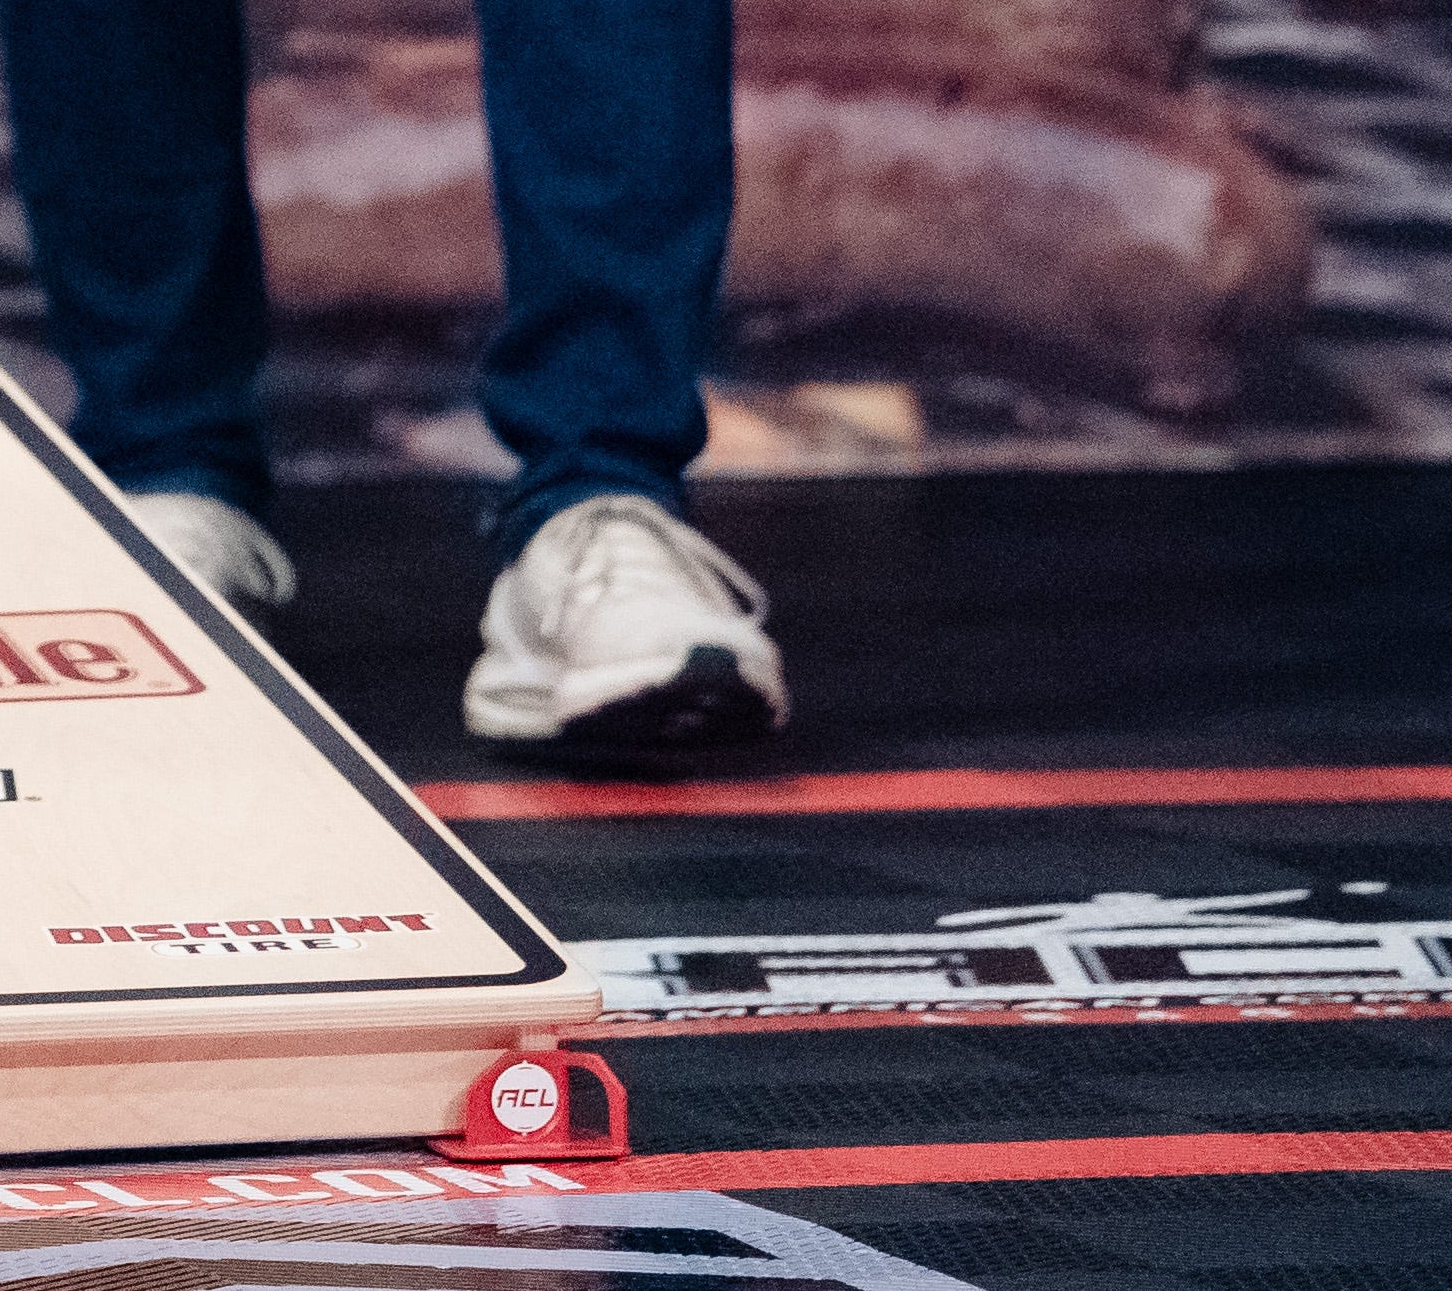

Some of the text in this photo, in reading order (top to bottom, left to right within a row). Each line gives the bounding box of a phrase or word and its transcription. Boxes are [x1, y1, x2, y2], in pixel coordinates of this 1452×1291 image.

[48, 913, 434, 945] DISCOUNT
[169, 937, 341, 954] TIRE
[496, 1088, 555, 1109] ACL
